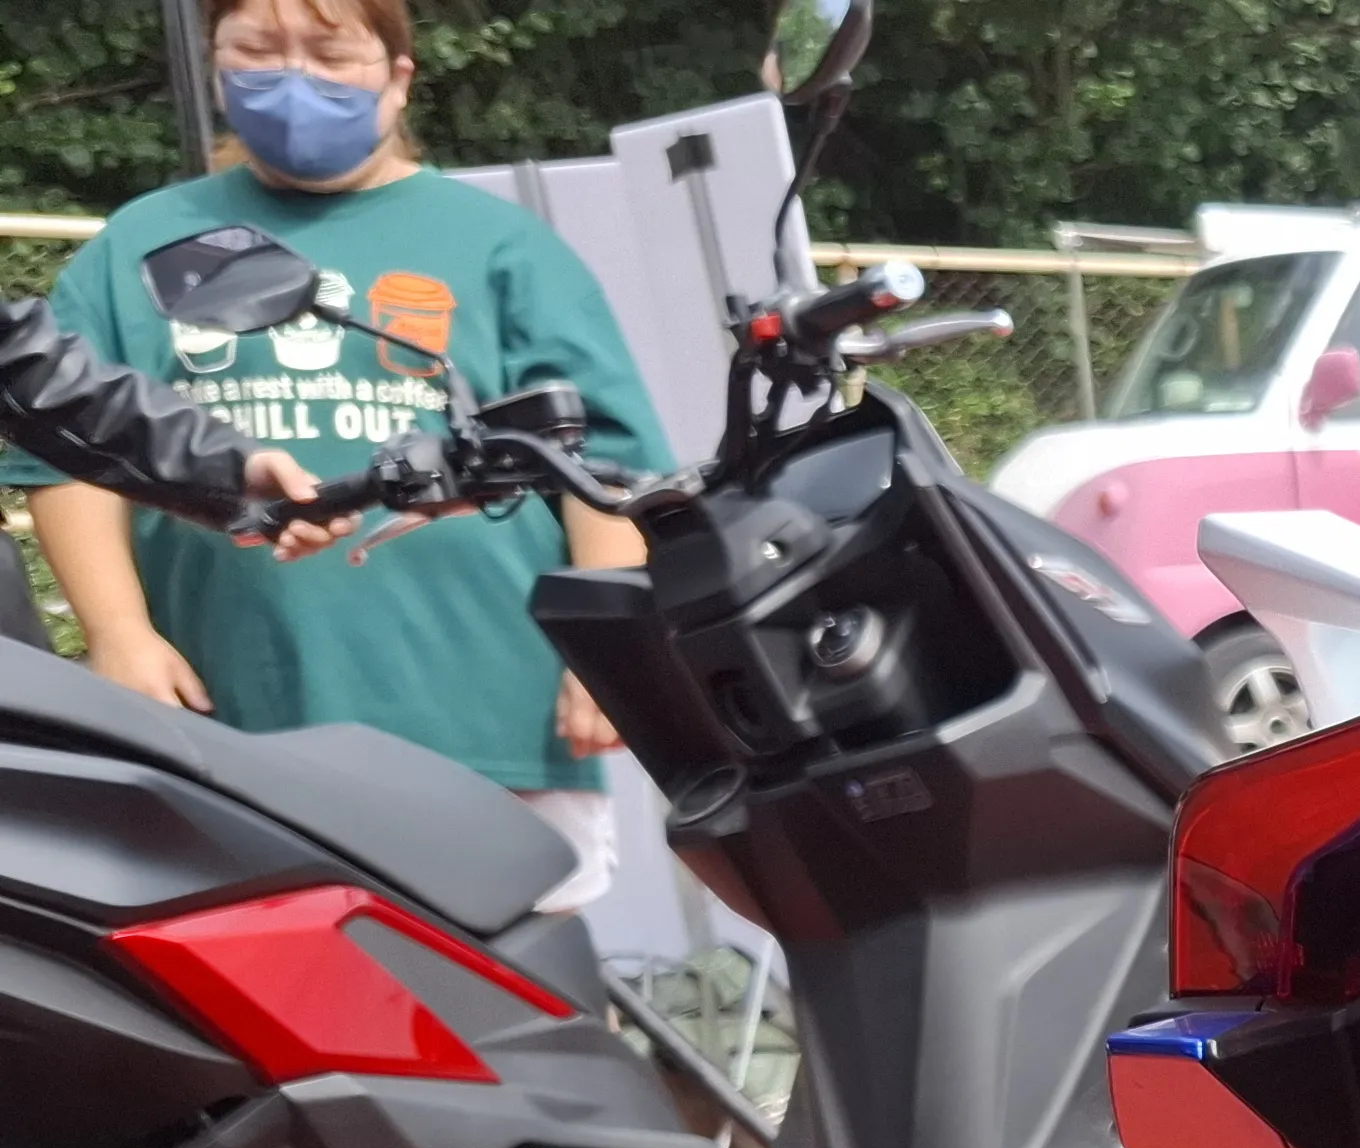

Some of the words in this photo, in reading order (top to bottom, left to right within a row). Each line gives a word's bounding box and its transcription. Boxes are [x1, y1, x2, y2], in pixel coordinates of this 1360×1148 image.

[222, 376, 241, 401] a
[242, 373, 294, 400] rest
[296, 371, 353, 400] with
[356, 378, 374, 401] a
[335, 402, 416, 442] OUT
